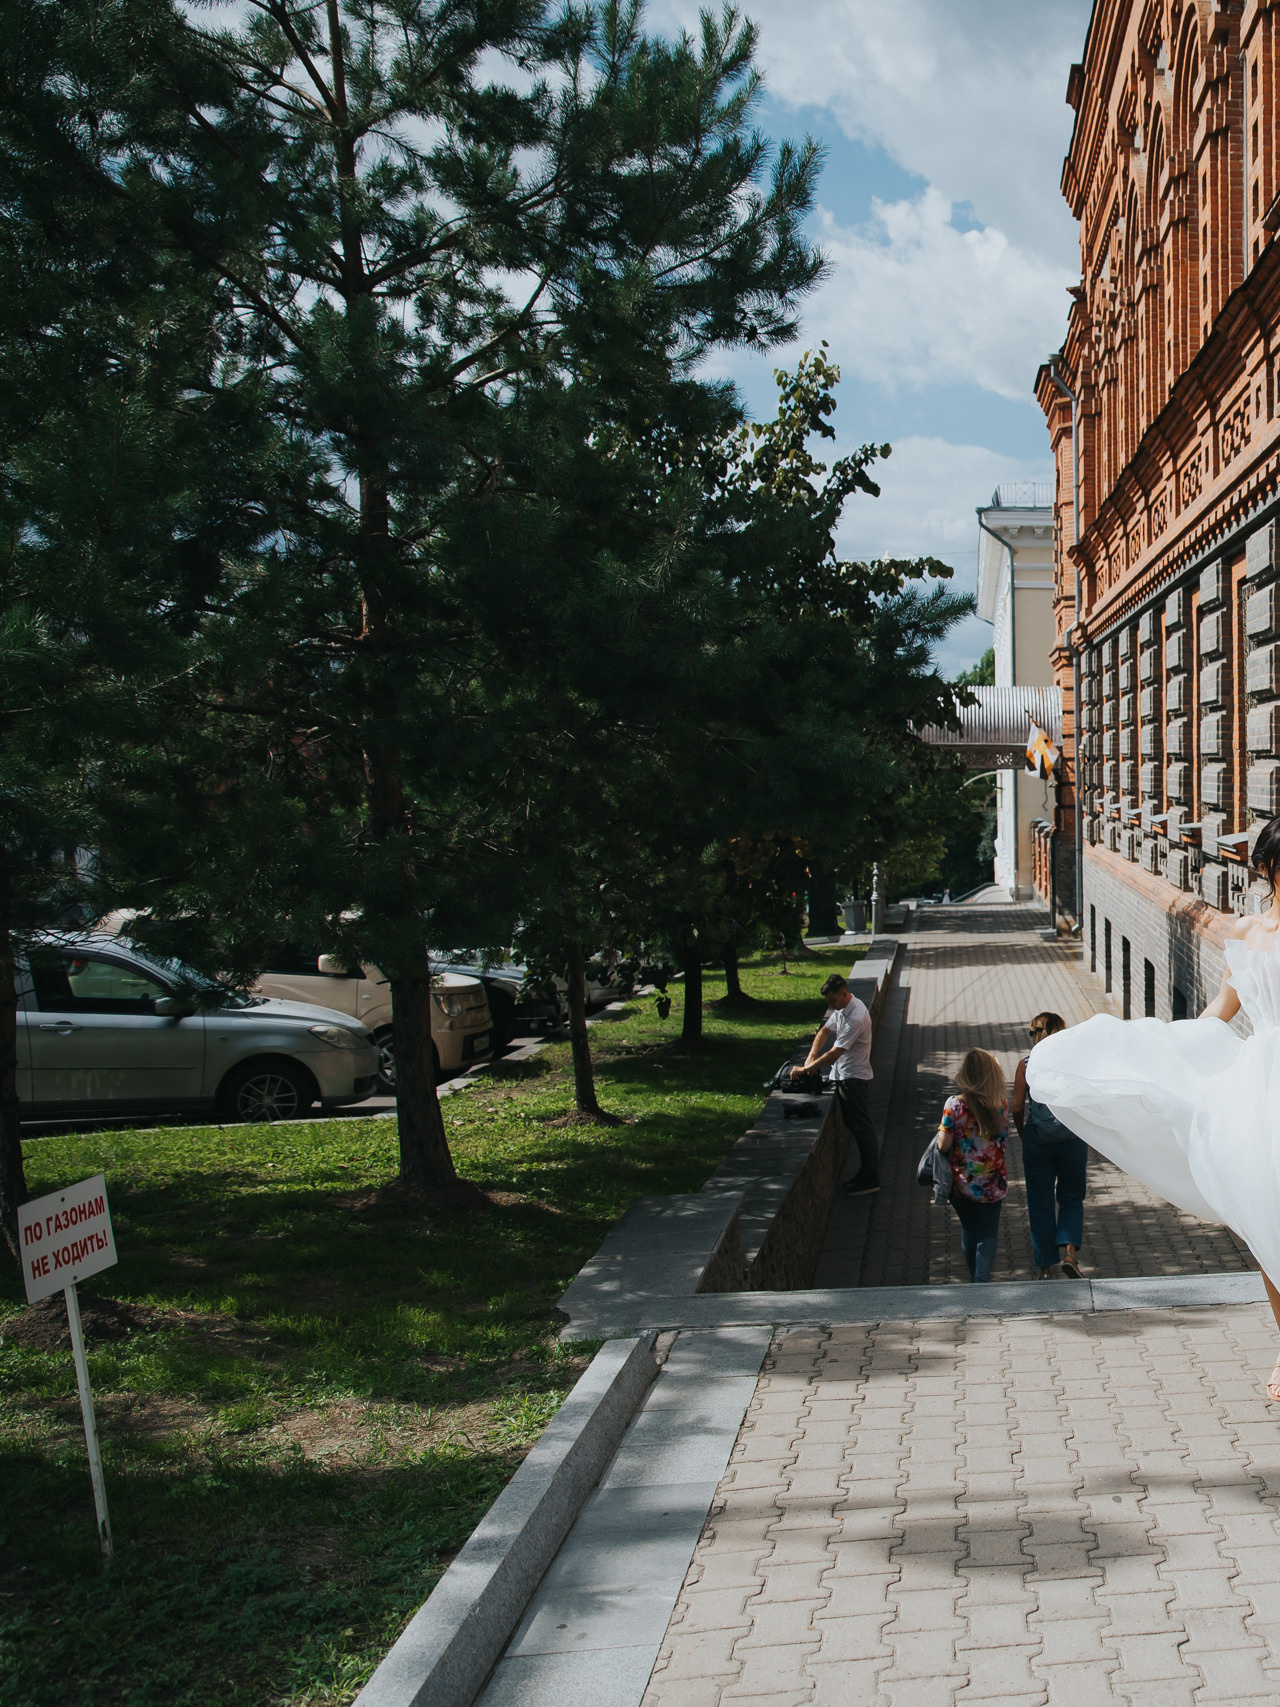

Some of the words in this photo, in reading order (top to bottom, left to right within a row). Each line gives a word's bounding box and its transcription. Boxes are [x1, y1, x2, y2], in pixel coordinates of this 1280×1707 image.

[24, 1221, 43, 1246] ПО
[46, 1195, 105, 1236] ГАЗОНАМ
[31, 1254, 51, 1280] НЕ
[52, 1228, 108, 1271] ХОДИТЬ!
